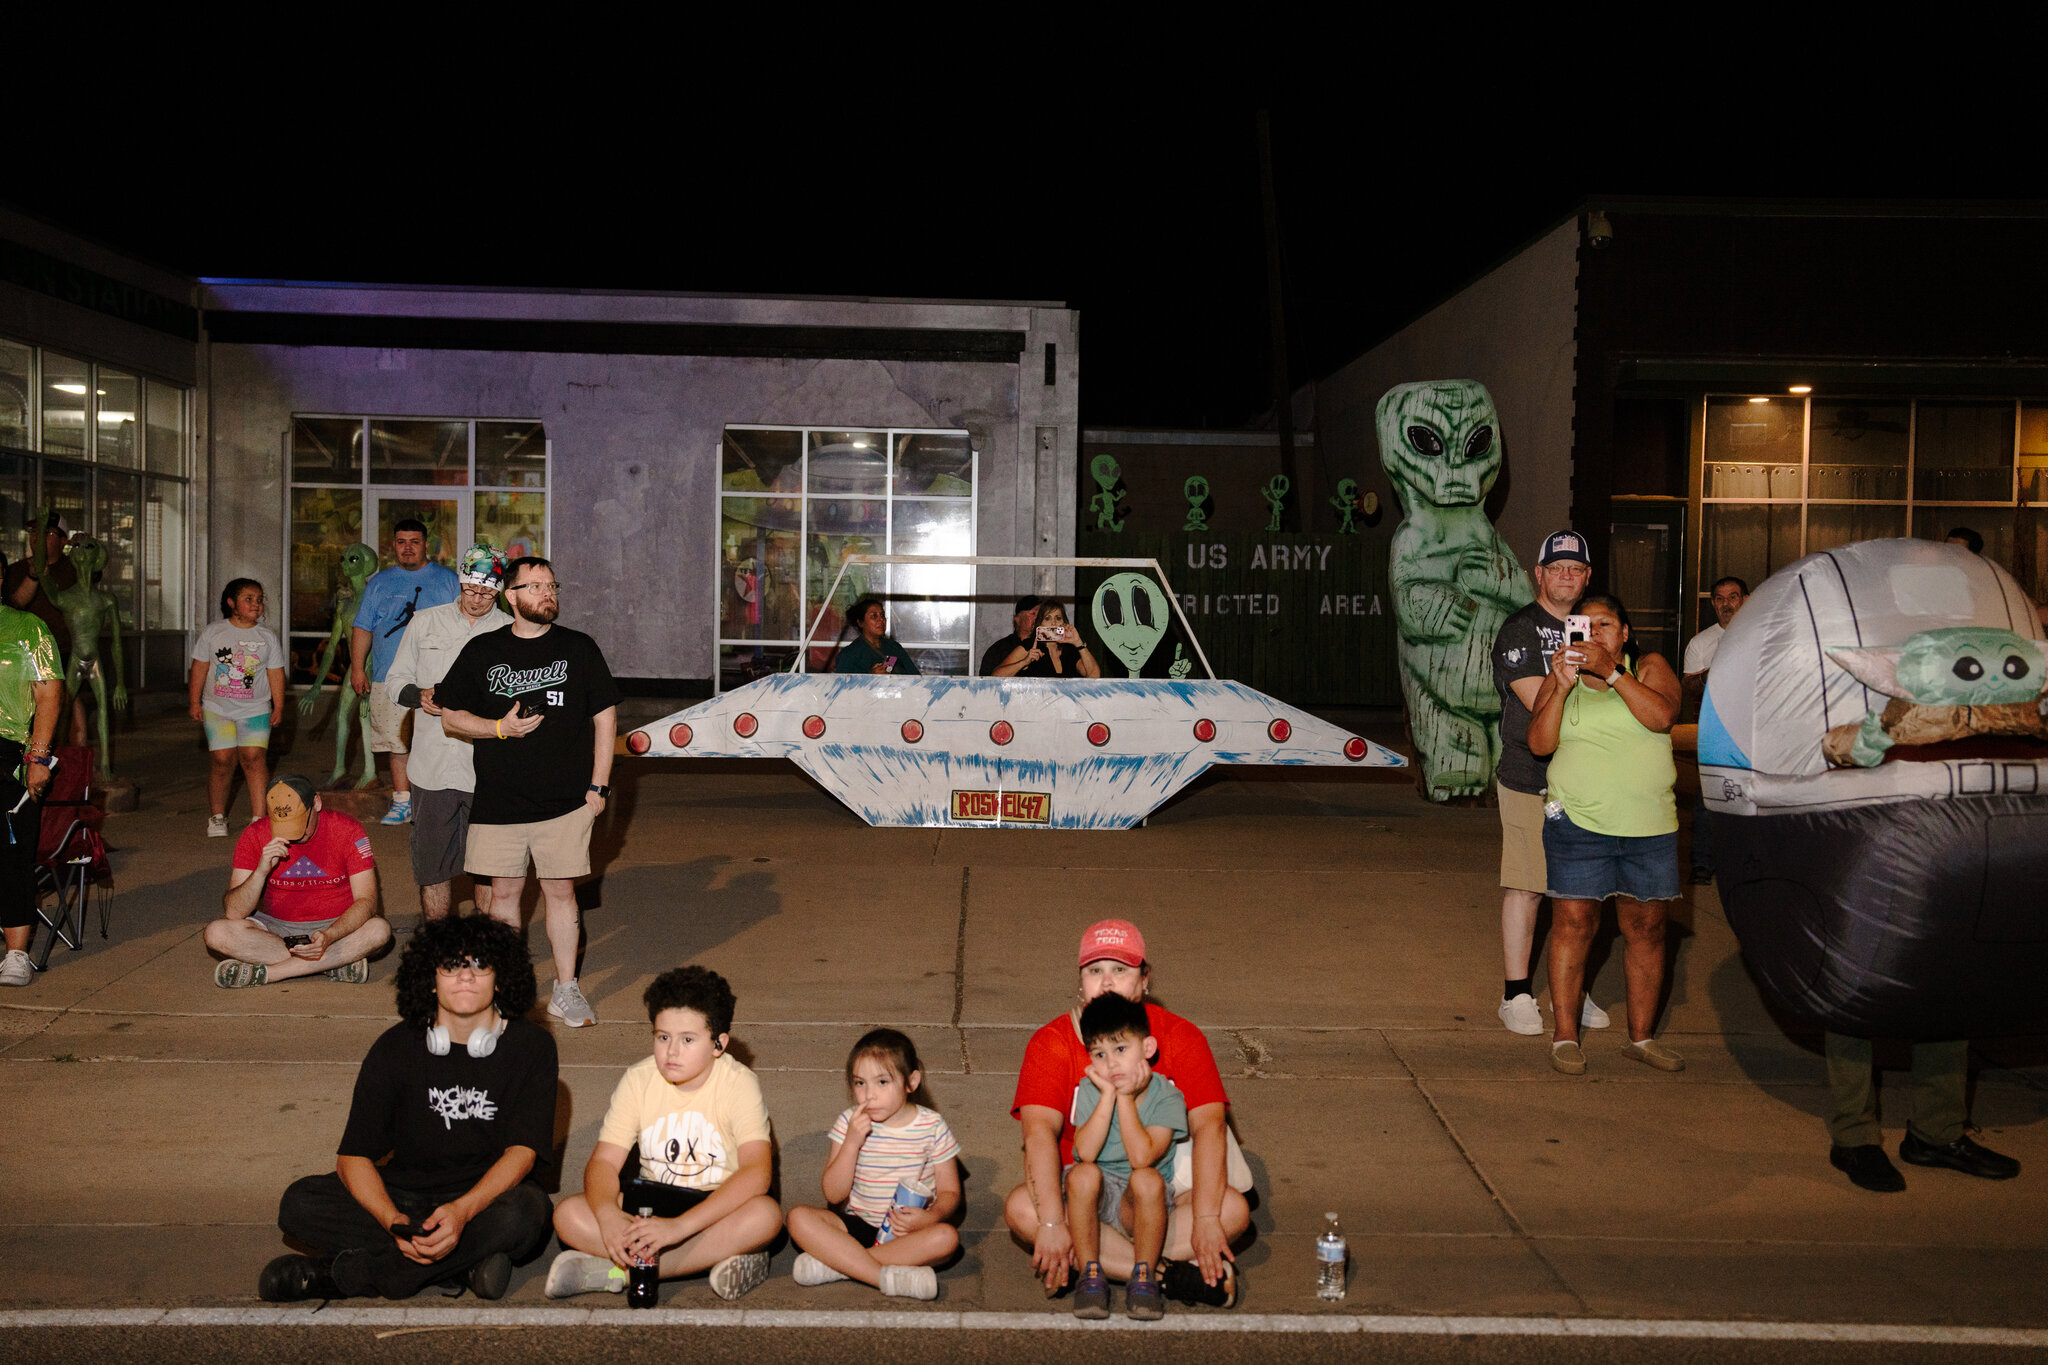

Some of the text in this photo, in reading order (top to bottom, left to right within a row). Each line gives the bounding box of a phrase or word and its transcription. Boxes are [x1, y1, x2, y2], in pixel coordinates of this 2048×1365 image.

[1187, 544, 1332, 571] US ARMY
[1167, 593, 1383, 615] TRICTED AREA
[487, 660, 568, 692] Roswell
[546, 690, 564, 706] 51
[269, 878, 295, 886] OLDS
[1094, 928, 1128, 937] TEXAS
[1096, 936, 1124, 945] TECH
